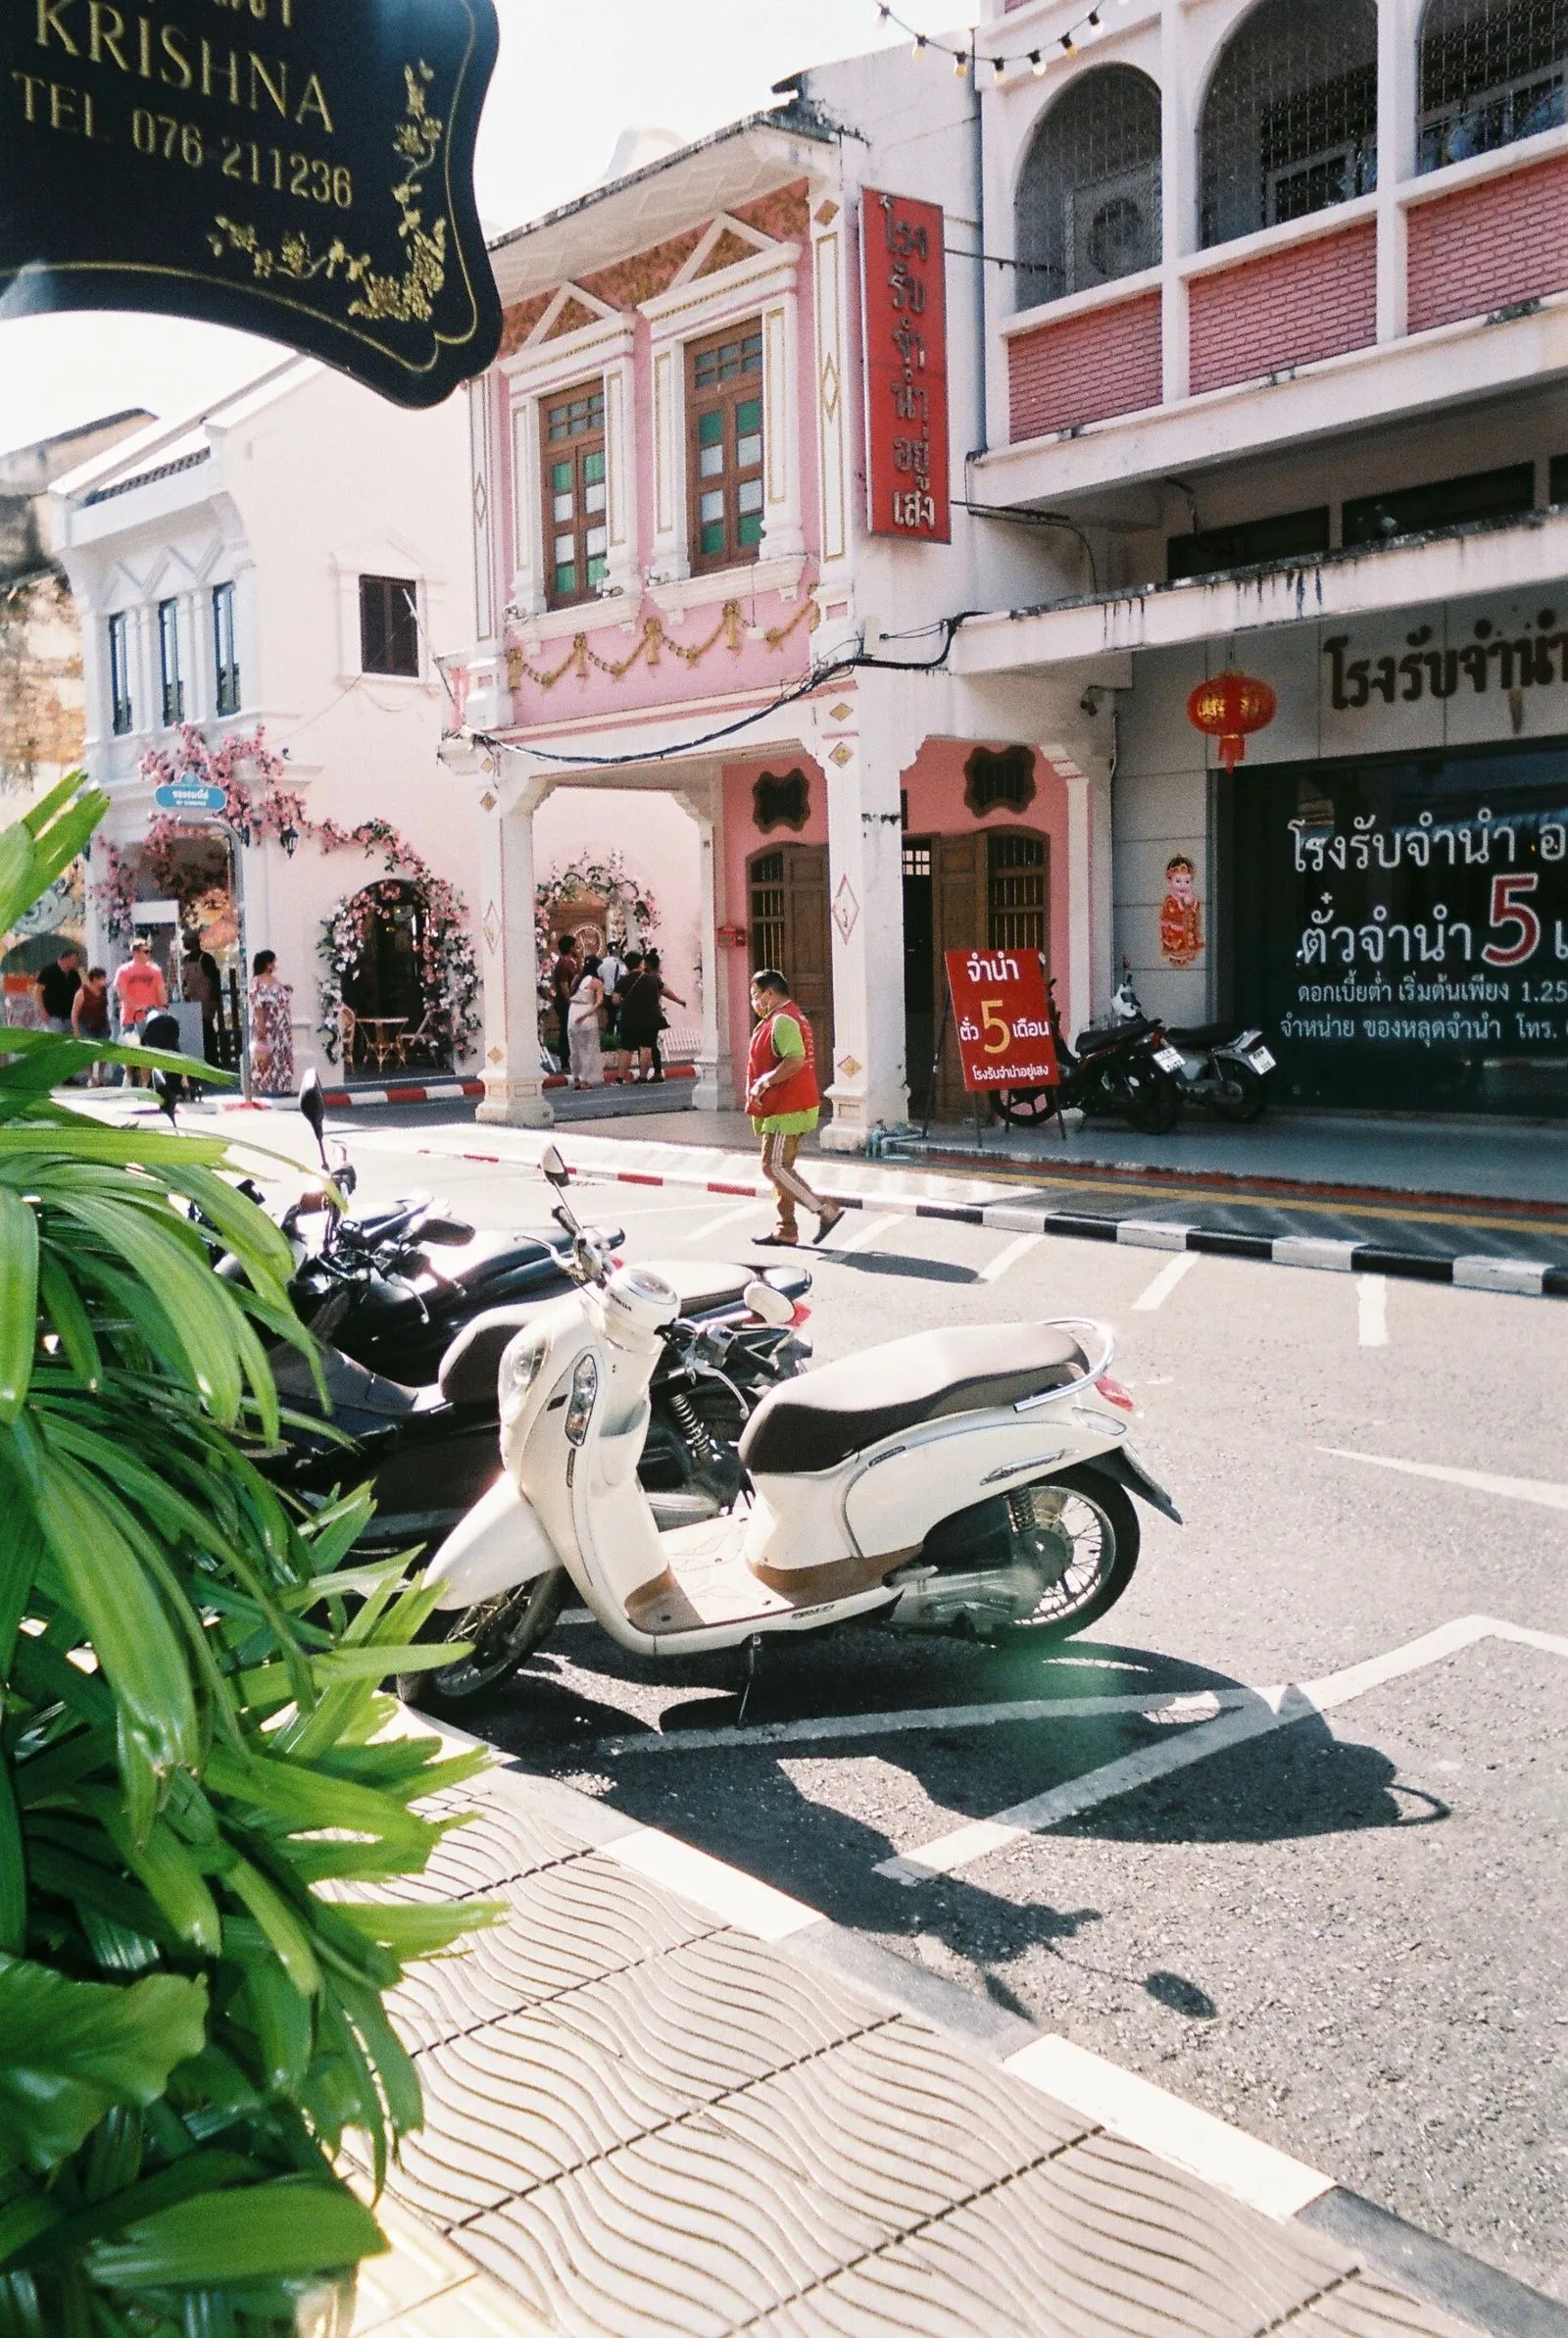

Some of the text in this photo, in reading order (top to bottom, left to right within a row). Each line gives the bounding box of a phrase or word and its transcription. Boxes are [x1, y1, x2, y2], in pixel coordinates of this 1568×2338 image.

[36, 0, 335, 134] KRISHNA
[132, 109, 205, 168] 076
[222, 136, 353, 209] 211236
[1288, 807, 1515, 872] โรงรับจำนำ
[1301, 891, 1472, 964] ตั๋วจำนำ
[1481, 872, 1541, 967] 5
[965, 951, 1020, 982] จำนำ
[1298, 970, 1392, 1002] ดอกเบี้ยต่ำ
[1398, 970, 1510, 1002] เริ่มต้นเพียง
[981, 999, 1011, 1054] 5
[1012, 1017, 1050, 1038] เดือน
[1280, 1012, 1355, 1038] จำหน่าย
[1363, 1012, 1501, 1049] ของหลุดจำนำ
[1515, 1013, 1558, 1040] โทร.
